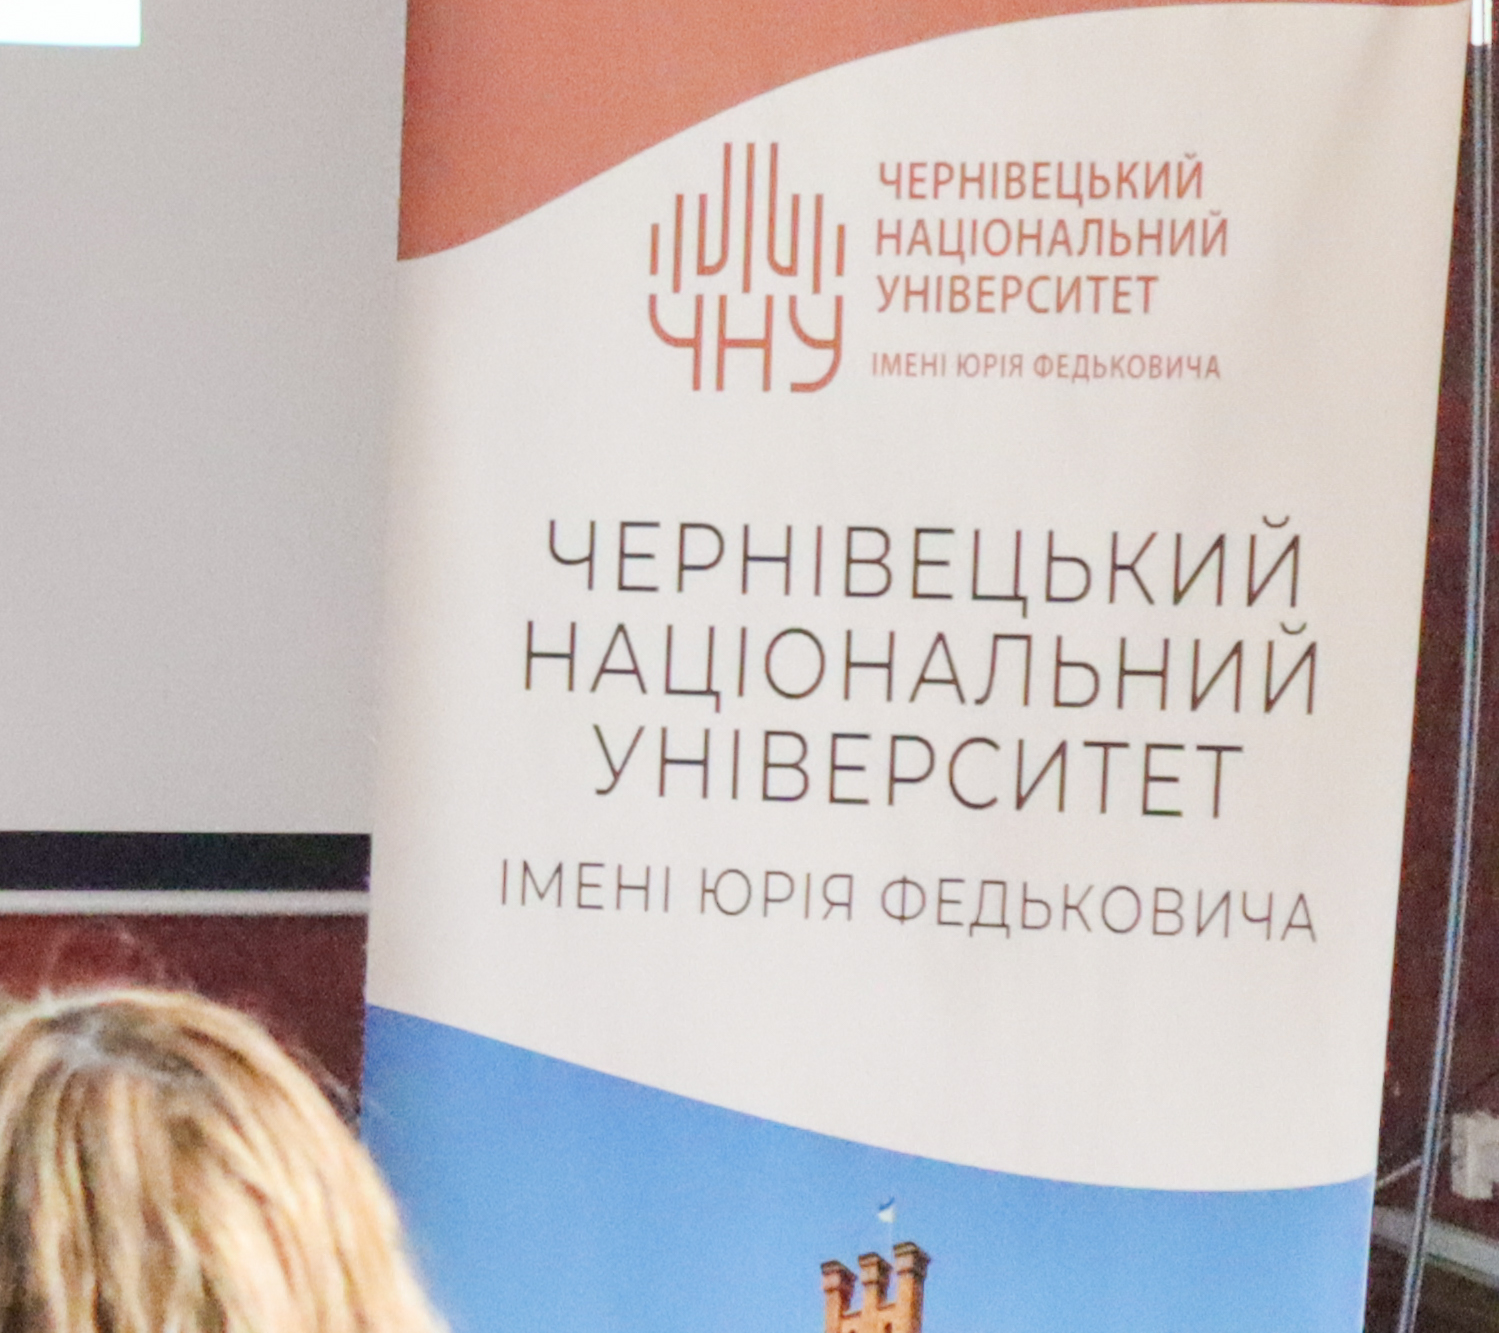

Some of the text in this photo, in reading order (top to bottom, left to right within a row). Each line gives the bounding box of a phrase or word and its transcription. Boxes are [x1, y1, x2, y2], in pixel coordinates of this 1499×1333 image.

[878, 152, 1204, 207] ЧЕРНІВЕЦЬКИЙ
[876, 210, 1229, 264] НАЦІОНАЛЬНИЙ
[876, 273, 1160, 315] УНІВЕРСИТЕТ
[873, 352, 1222, 382] ІМЕНІ ЮРІЯ ФЕДЬКОВИЧА
[548, 515, 1301, 619] ЧЕРНІВЕЦЬКИЙ
[524, 620, 1318, 716] НАЦІОНАЛЬНИЙ
[593, 724, 1244, 819] УНІВЕРСИТЕТ
[500, 859, 1317, 943] ІМЕНІ ЮРІЯ ФЕДЬКОВИЧА
